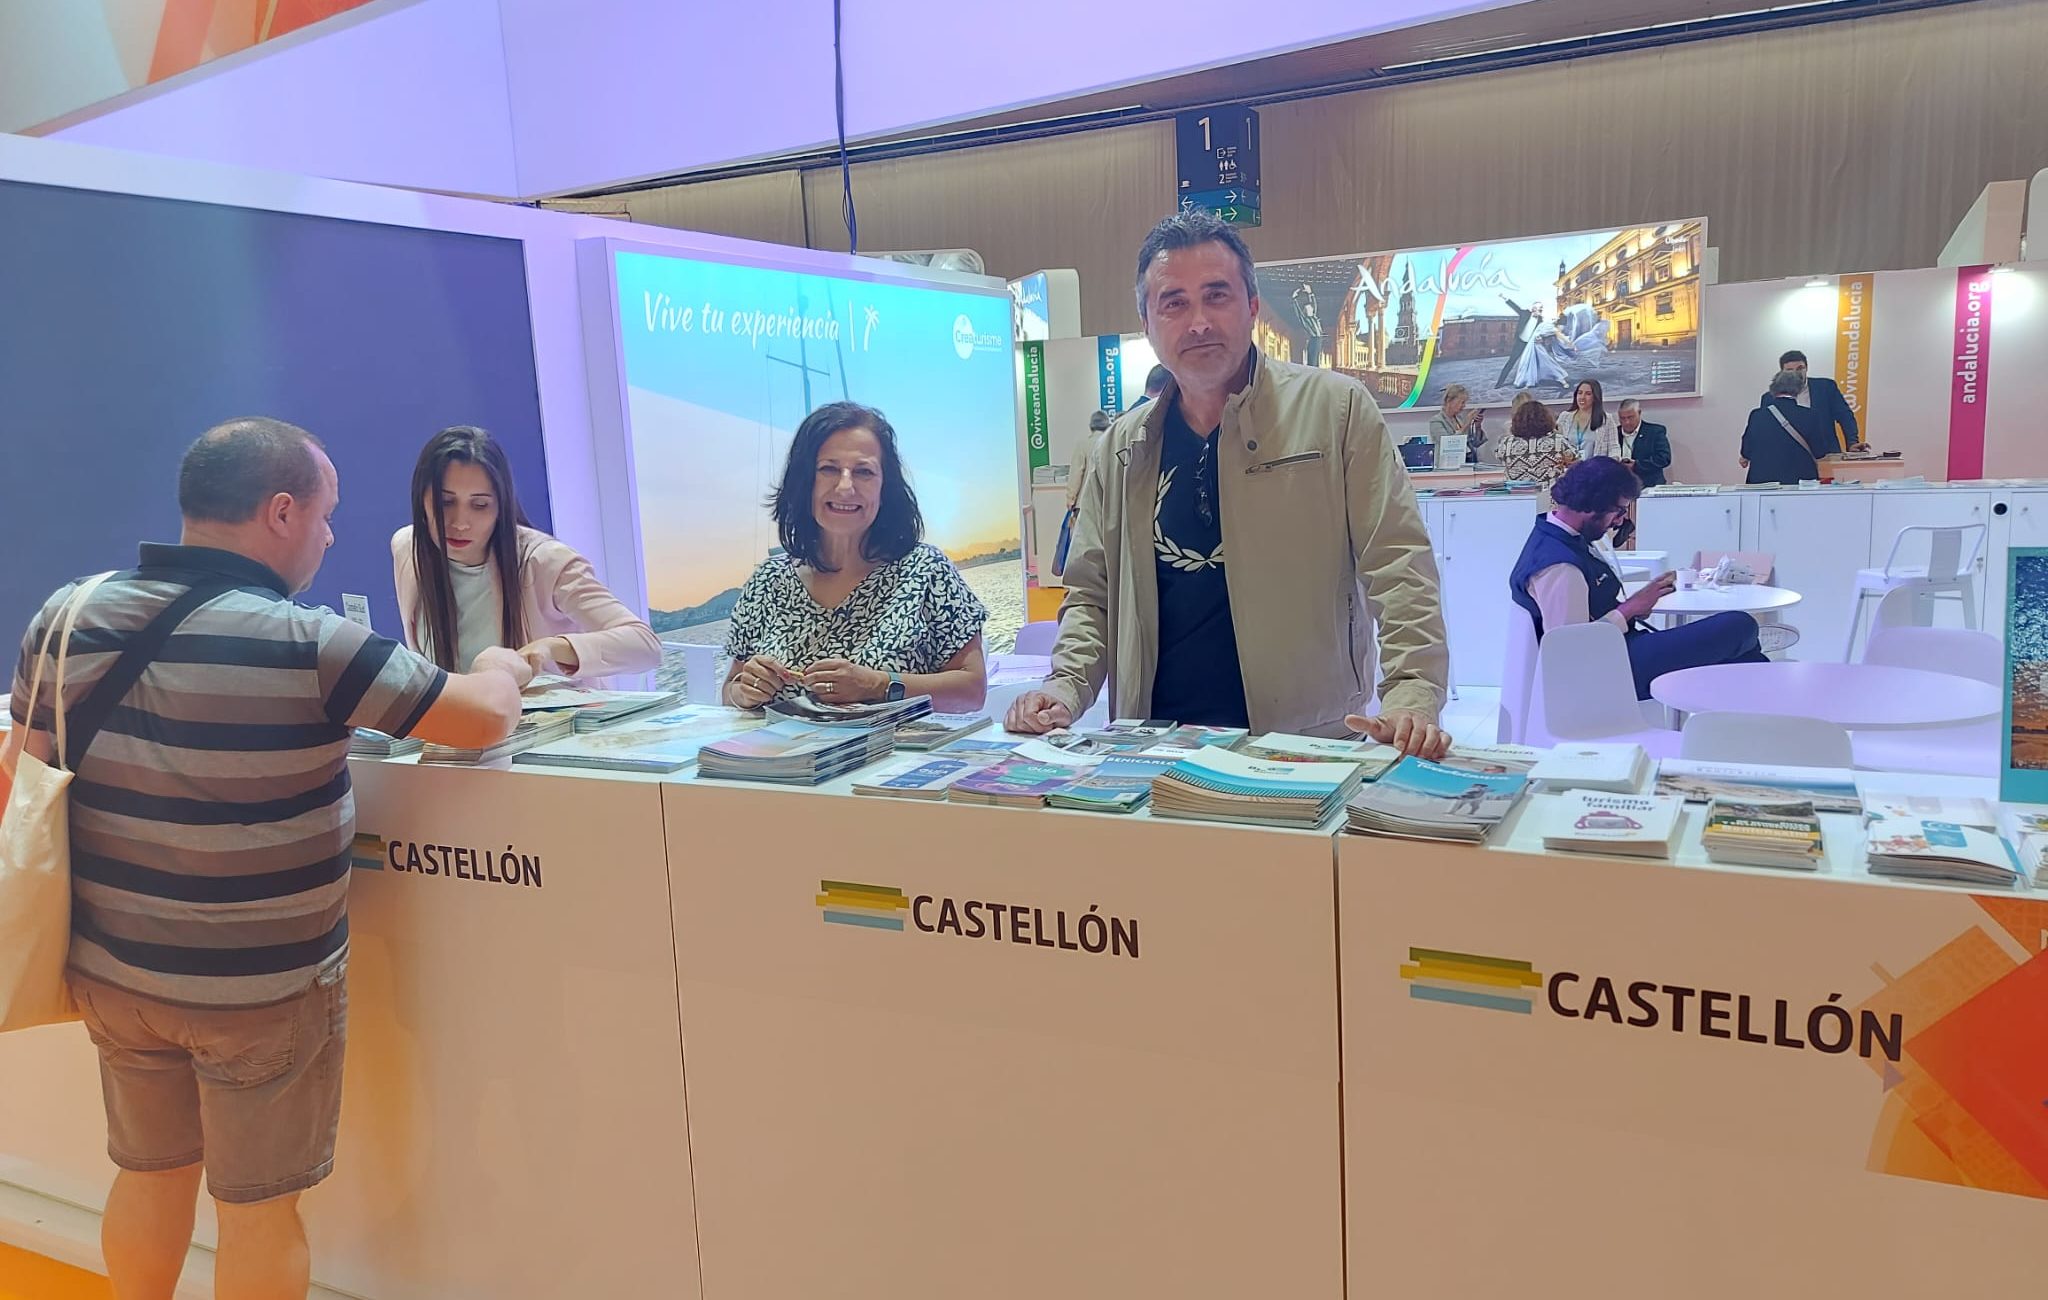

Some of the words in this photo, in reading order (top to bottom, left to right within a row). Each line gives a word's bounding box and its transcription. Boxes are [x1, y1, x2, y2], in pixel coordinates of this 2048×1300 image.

[1199, 117, 1211, 150] 1
[1352, 252, 1519, 302] Andalucía
[643, 290, 693, 332] Vive
[702, 304, 723, 332] tu
[731, 308, 839, 350] experiencia
[1957, 281, 1990, 403] andalucia.org
[1026, 346, 1046, 449] @viveandalucia
[1582, 796, 1650, 805] turismo
[1587, 802, 1656, 811] familiar
[389, 840, 542, 887] CASTELLÓN
[912, 895, 1139, 958] CASTELLÓN
[1547, 971, 1903, 1061] CASTELLÓN
